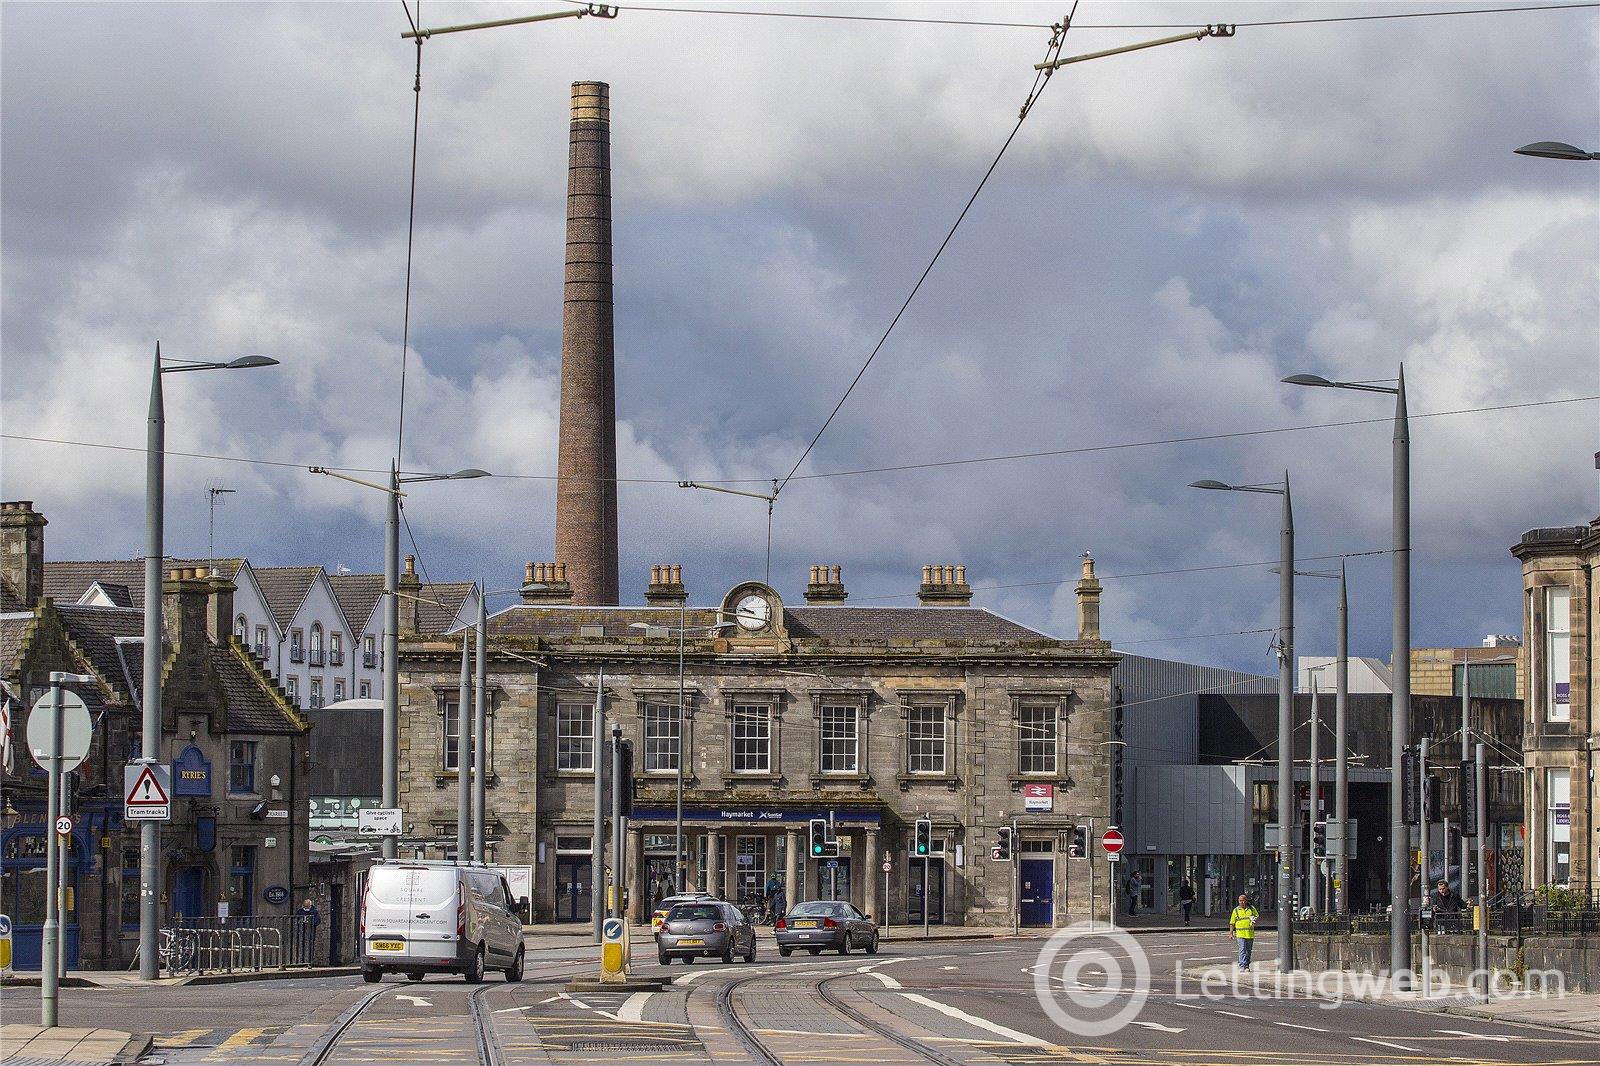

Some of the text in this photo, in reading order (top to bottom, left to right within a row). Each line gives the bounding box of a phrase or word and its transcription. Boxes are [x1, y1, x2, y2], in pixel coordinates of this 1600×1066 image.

[181, 770, 206, 779] RYRIE'S
[721, 811, 754, 819] Haymarket
[57, 821, 71, 830] 20
